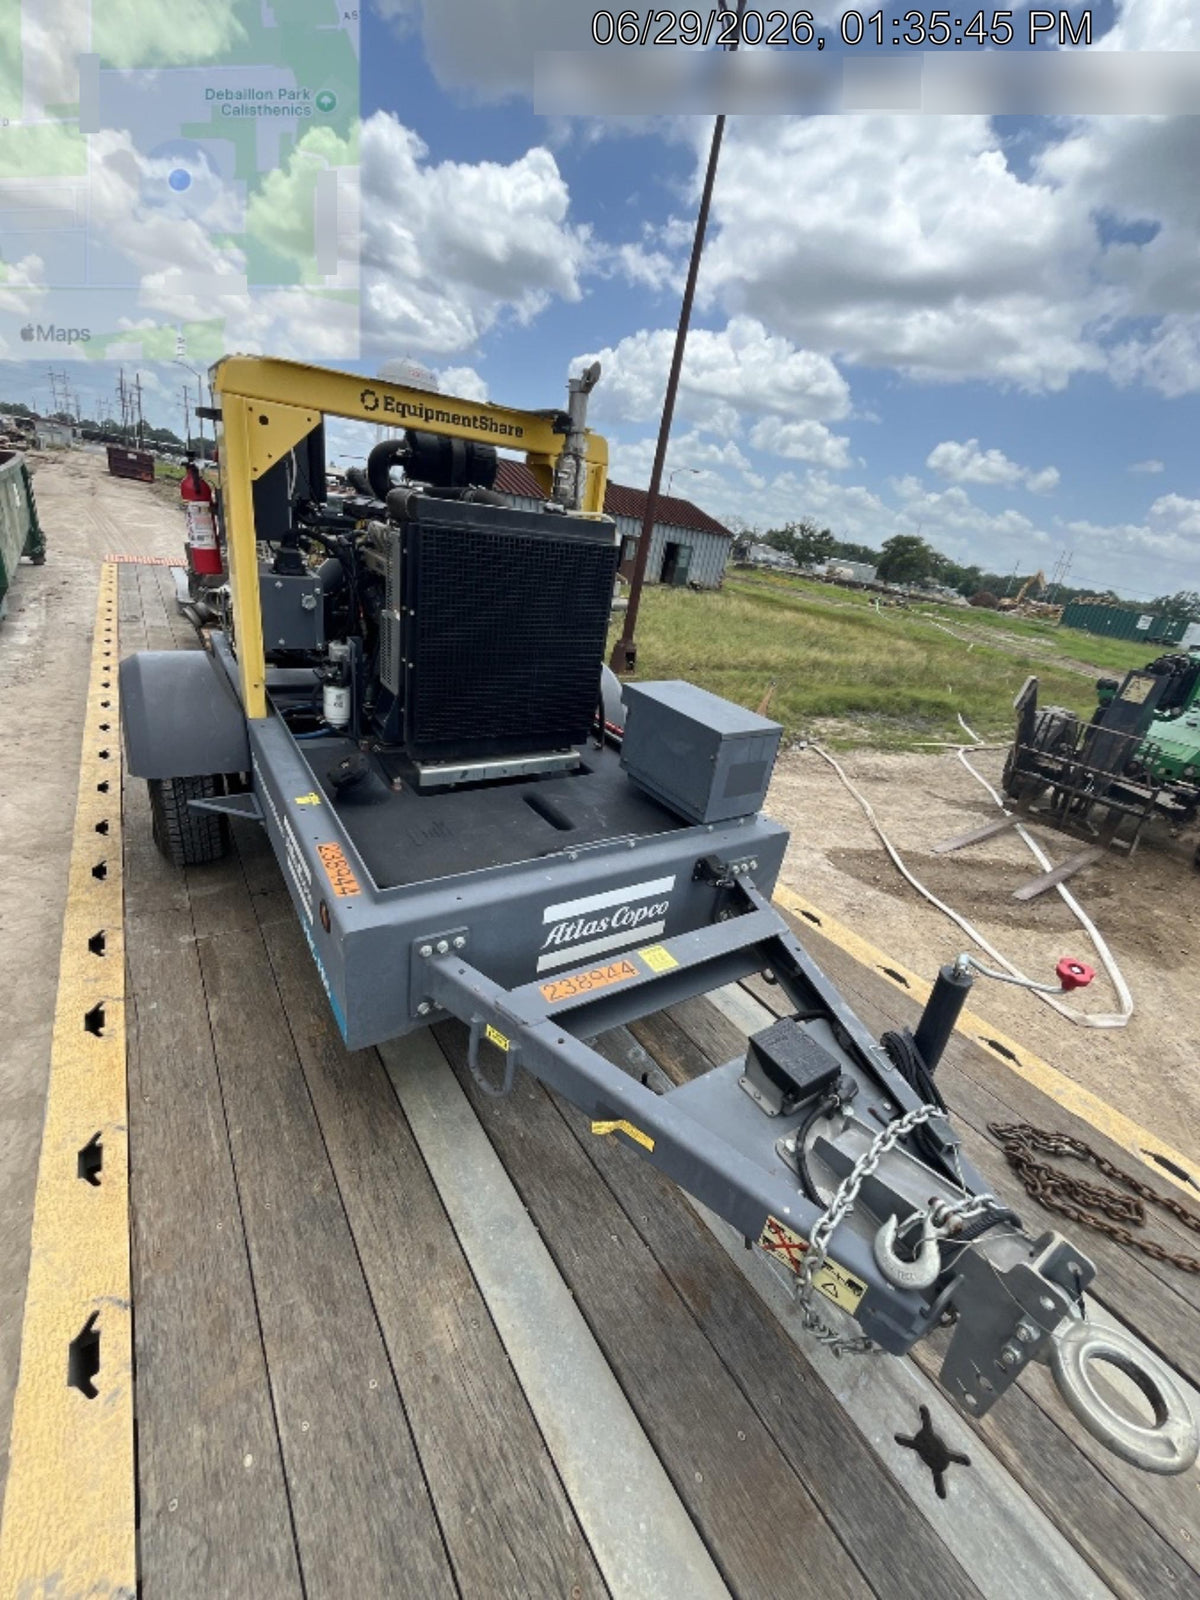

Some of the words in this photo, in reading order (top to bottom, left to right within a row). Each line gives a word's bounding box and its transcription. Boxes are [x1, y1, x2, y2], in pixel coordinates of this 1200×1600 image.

[383, 395, 524, 438] EquipmentShare
[540, 915, 611, 950] Atlas
[611, 900, 670, 928] Copco
[543, 959, 636, 1001] 238944
